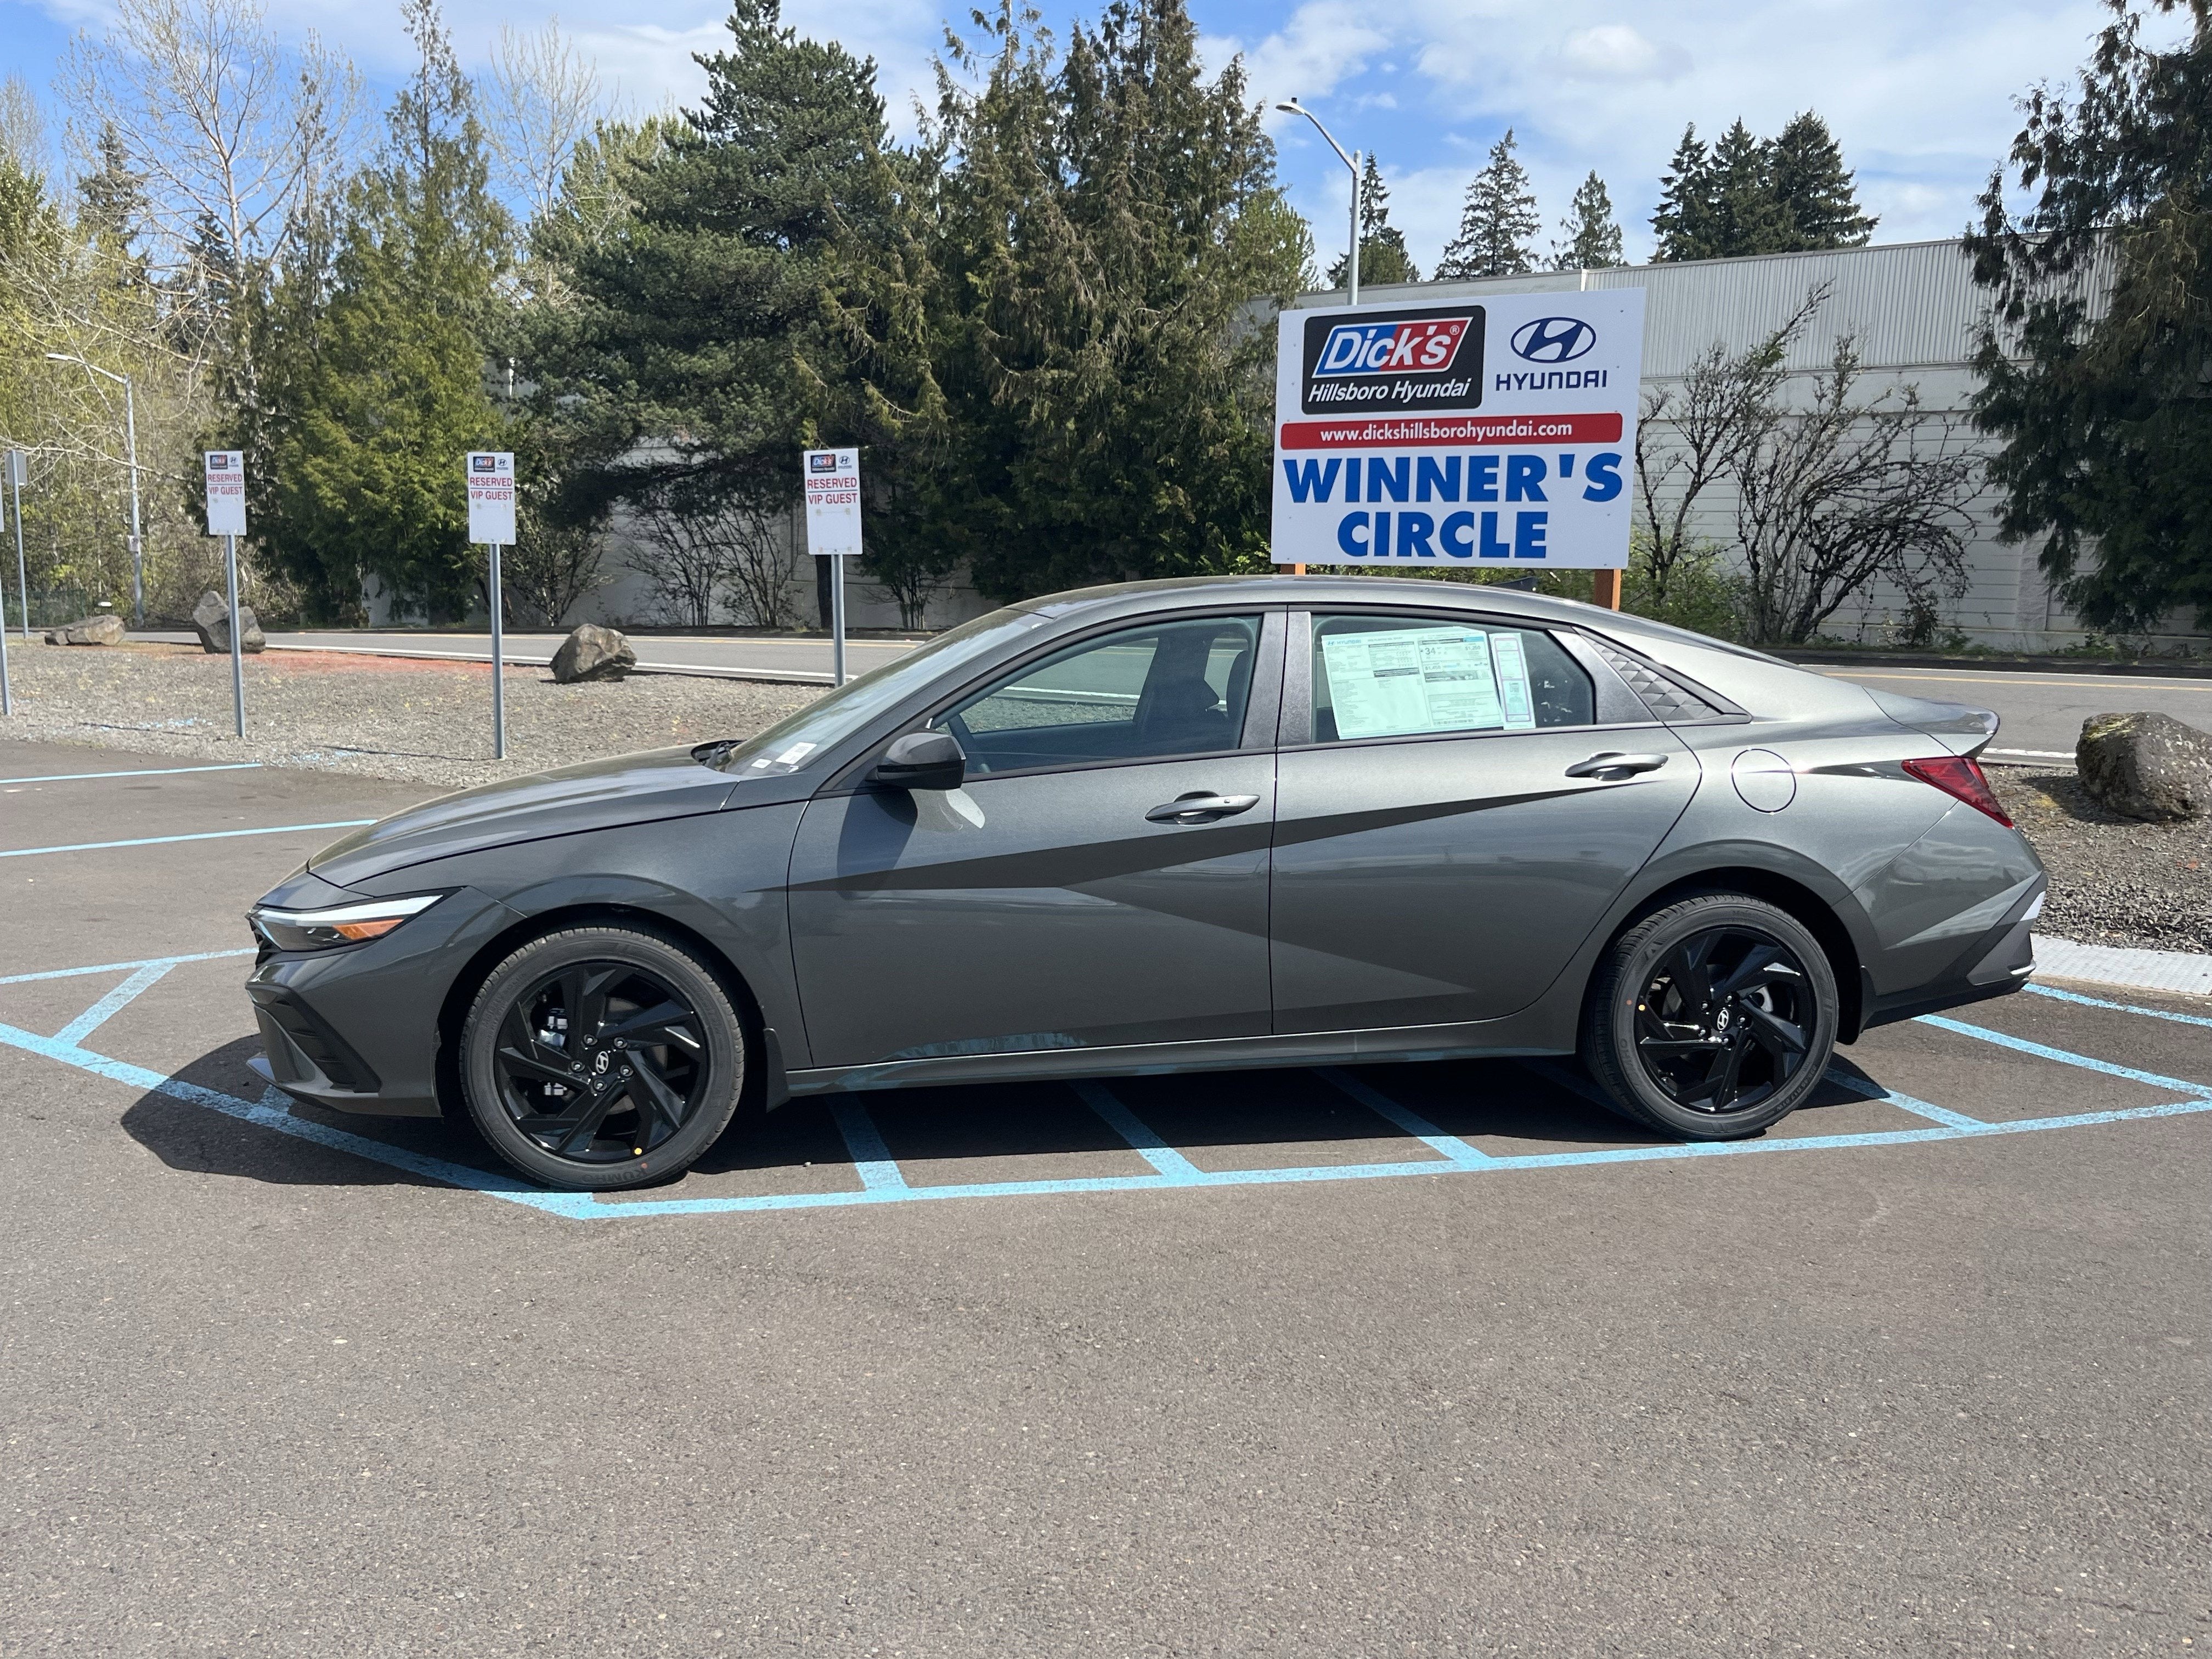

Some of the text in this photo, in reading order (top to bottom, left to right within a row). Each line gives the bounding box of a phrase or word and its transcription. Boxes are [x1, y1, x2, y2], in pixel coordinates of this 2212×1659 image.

[1496, 370, 1607, 391] HYUNDAI
[1308, 377, 1472, 403] Hillsboro Hyundai
[1321, 420, 1572, 442] www.dickshillsborohyundai.com
[208, 474, 242, 482] RESERVED
[470, 477, 512, 487] RESERVED
[807, 477, 857, 489] RESERVED
[1283, 452, 1623, 503] WINNER'S
[471, 490, 513, 500] VIP GUEST
[808, 493, 857, 504] VIP GUEST
[1338, 511, 1548, 558] CIRCLE
